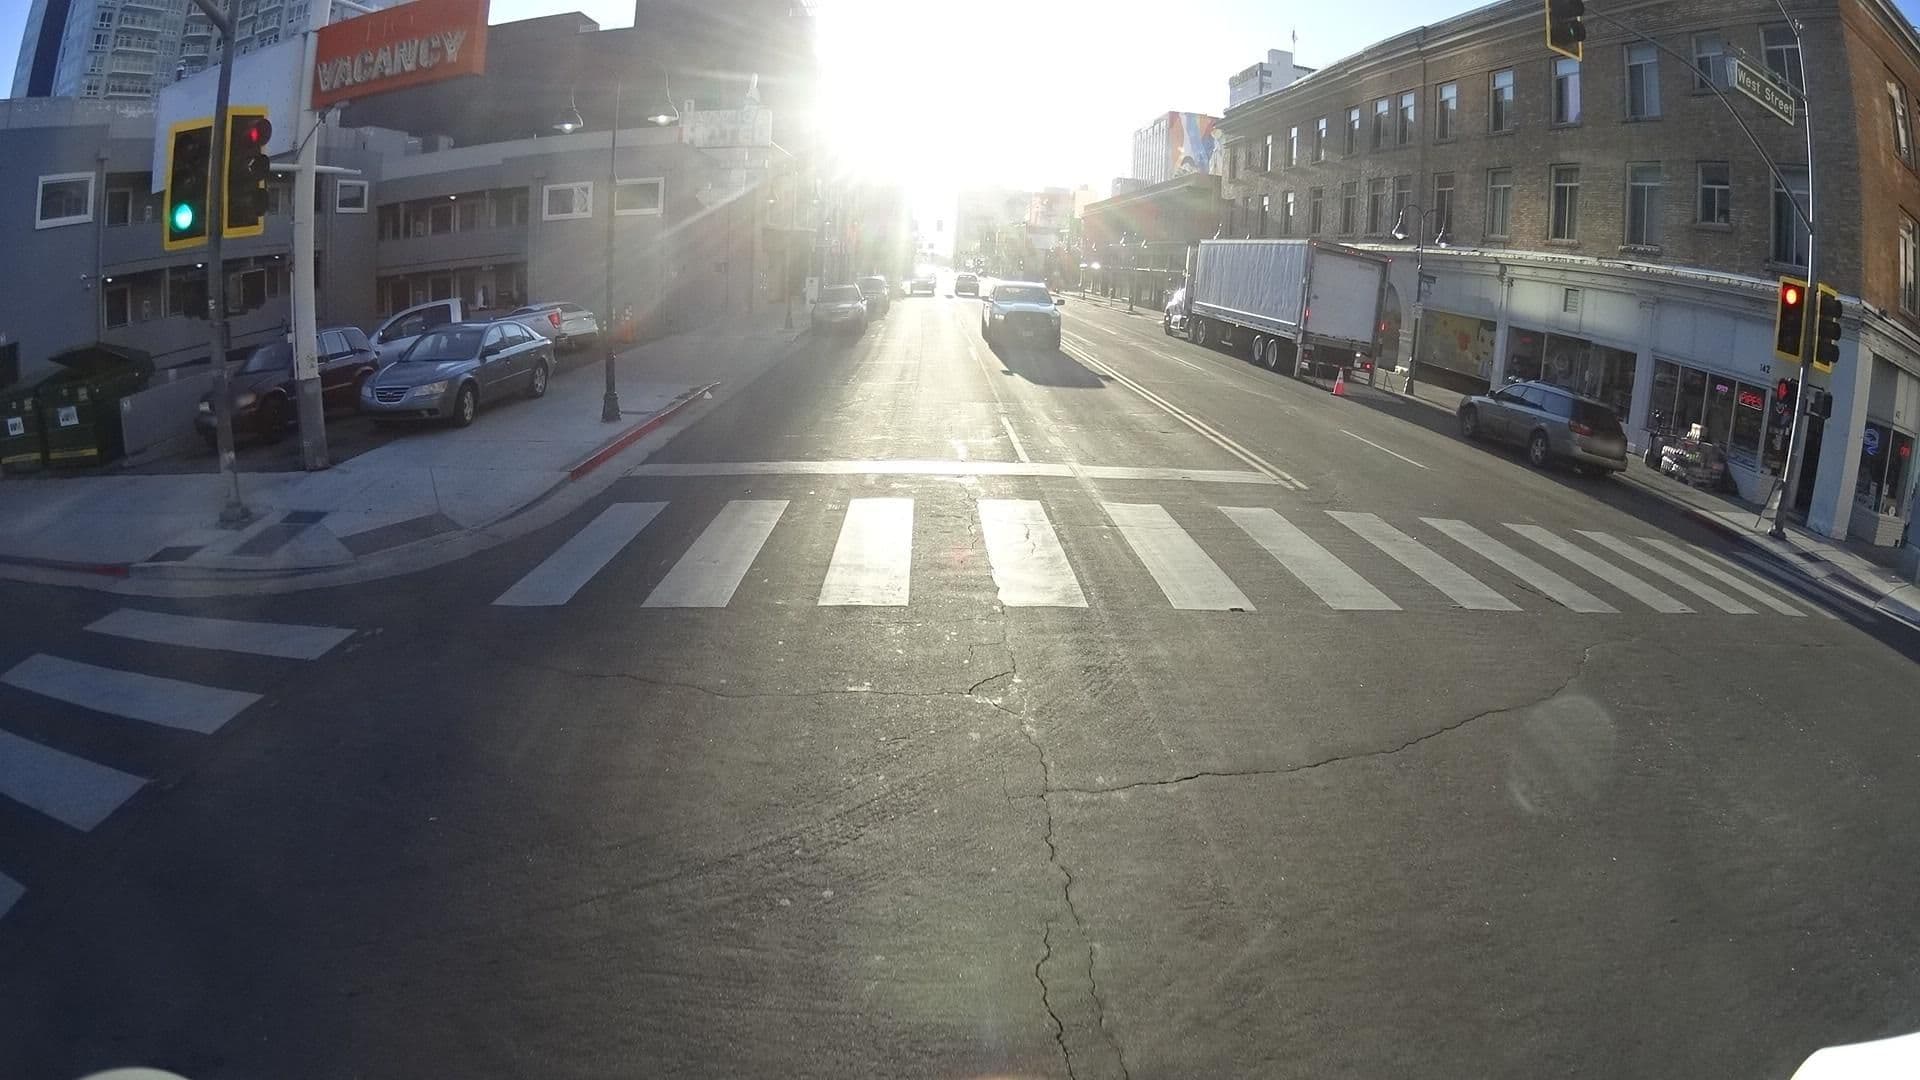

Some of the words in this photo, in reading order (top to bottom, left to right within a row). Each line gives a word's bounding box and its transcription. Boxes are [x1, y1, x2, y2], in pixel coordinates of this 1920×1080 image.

[318, 31, 466, 92] VACANCY
[1738, 68, 1760, 95] West
[1764, 87, 1793, 116] Street
